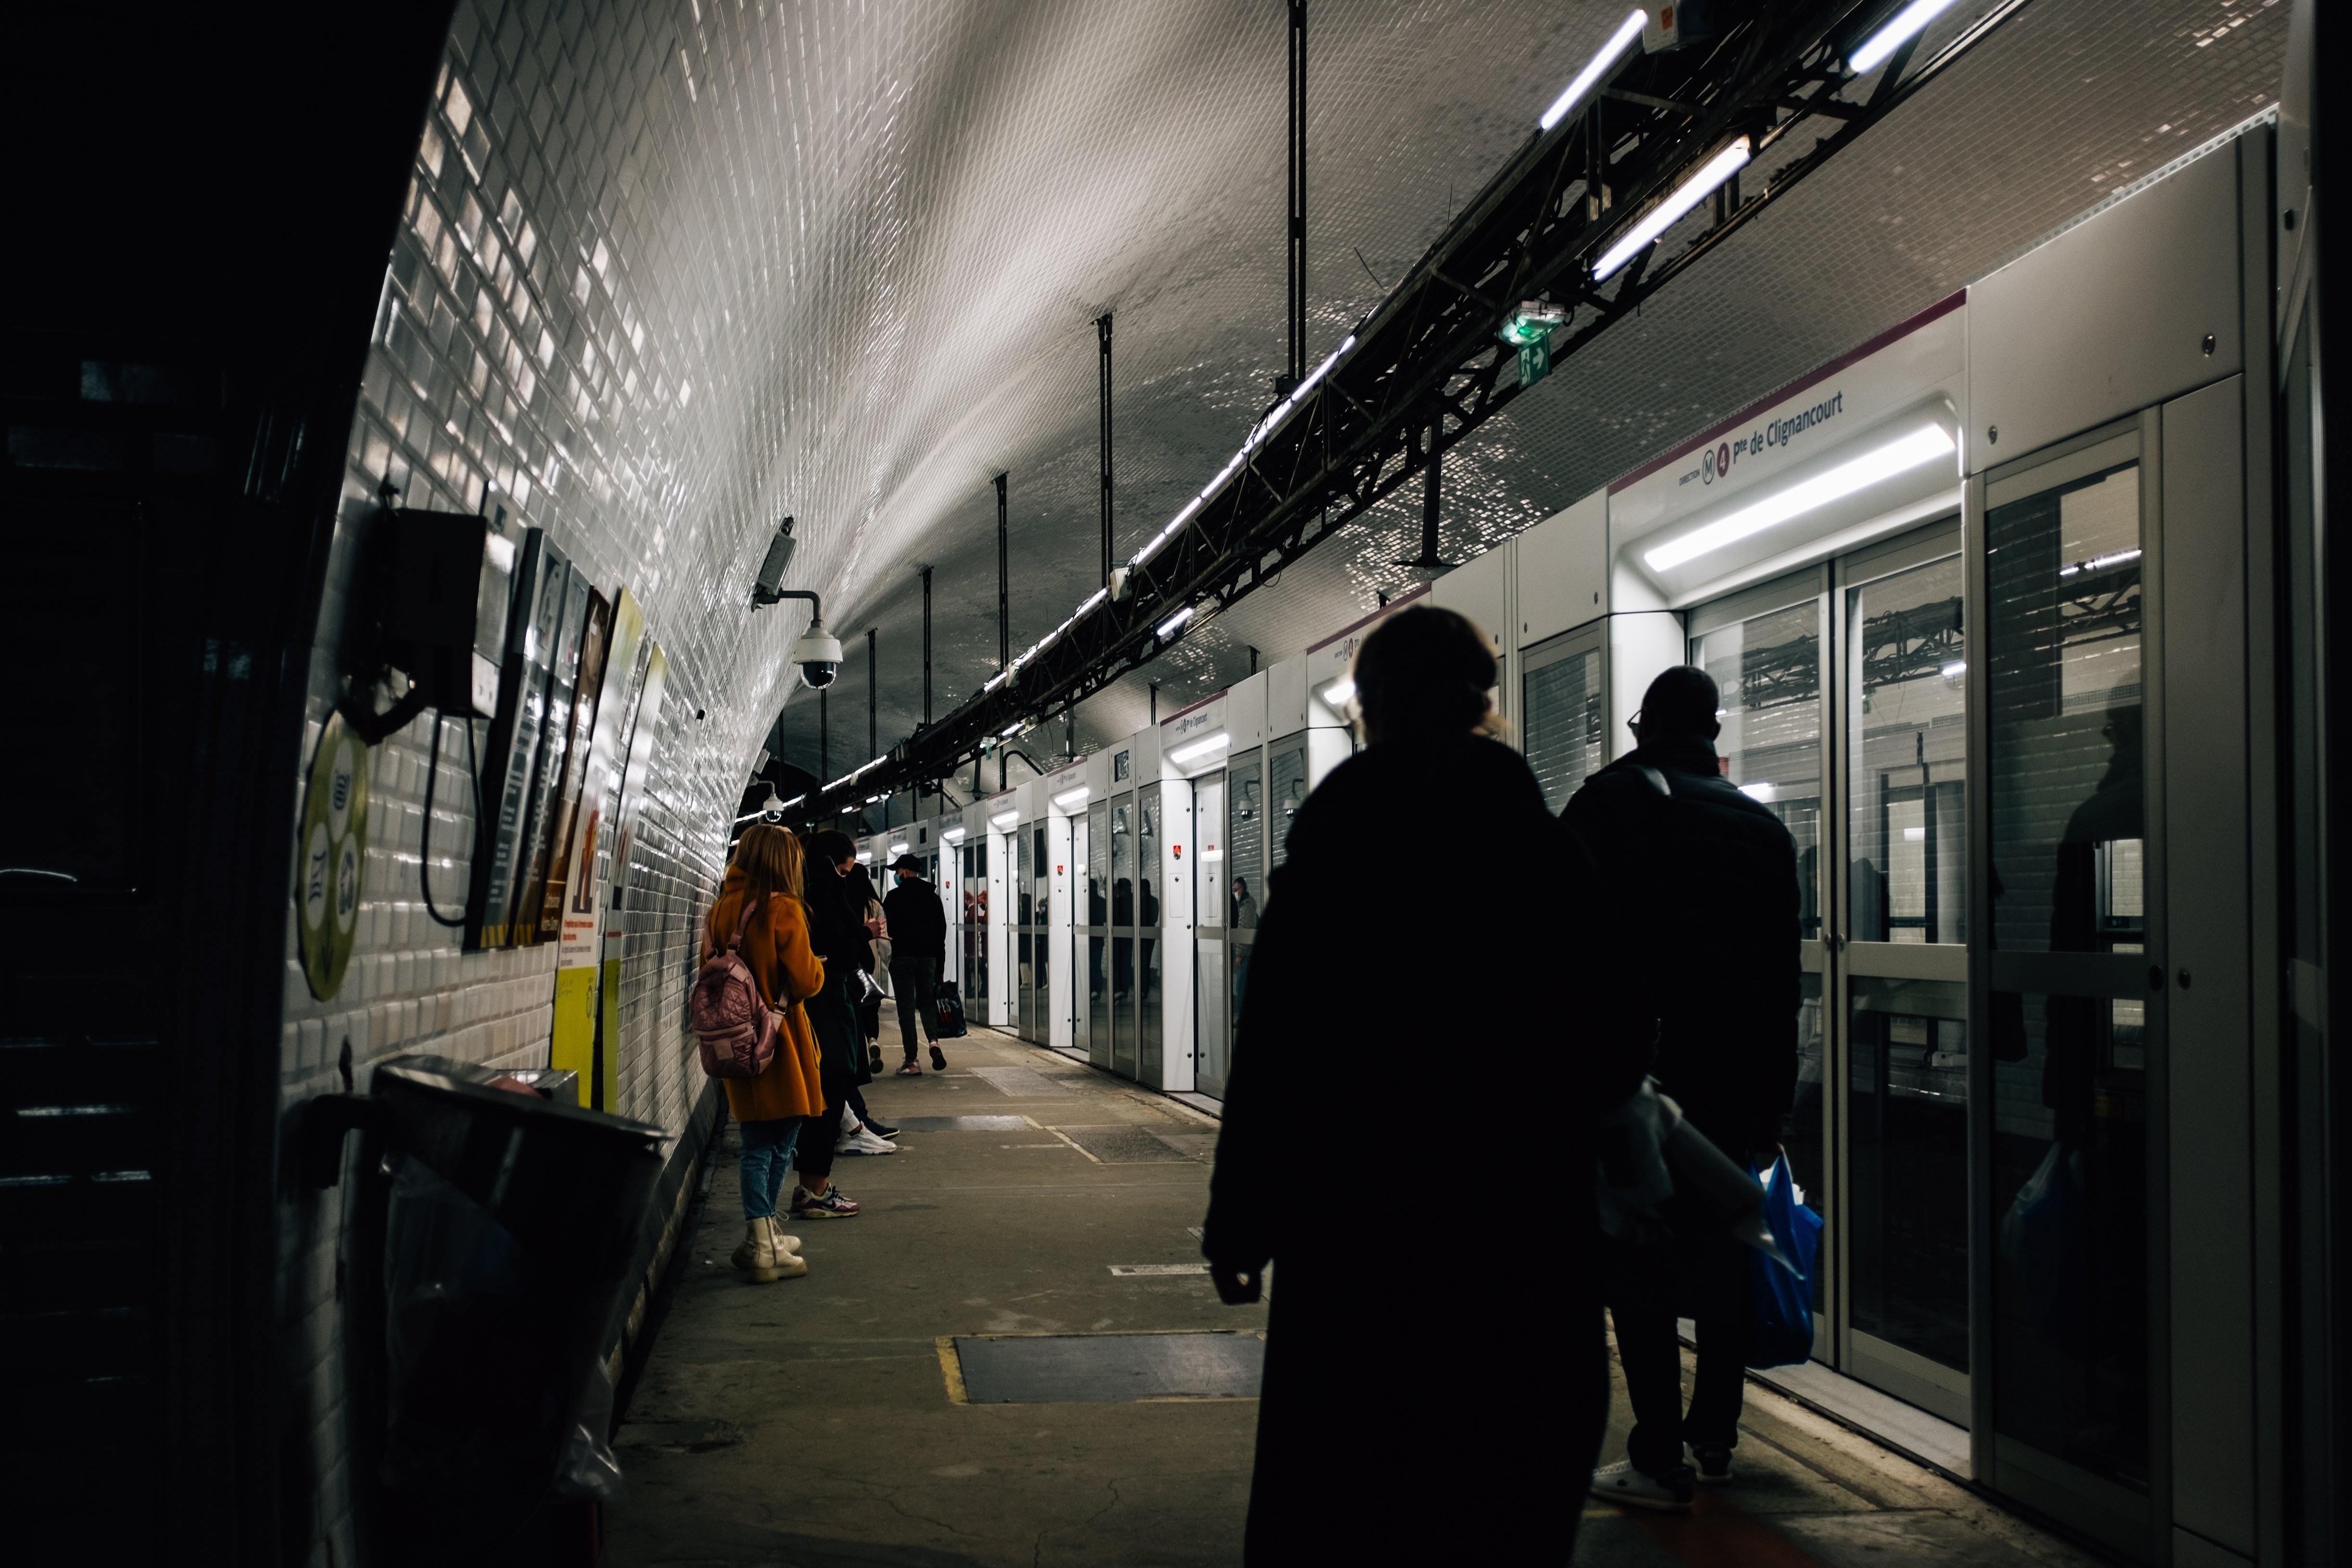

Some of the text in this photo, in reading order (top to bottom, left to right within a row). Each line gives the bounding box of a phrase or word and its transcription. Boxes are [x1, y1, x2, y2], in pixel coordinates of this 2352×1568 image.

[1679, 468, 1700, 486] DIRECTION
[1750, 431, 1764, 455] de
[1767, 390, 1843, 447] Clignancourt
